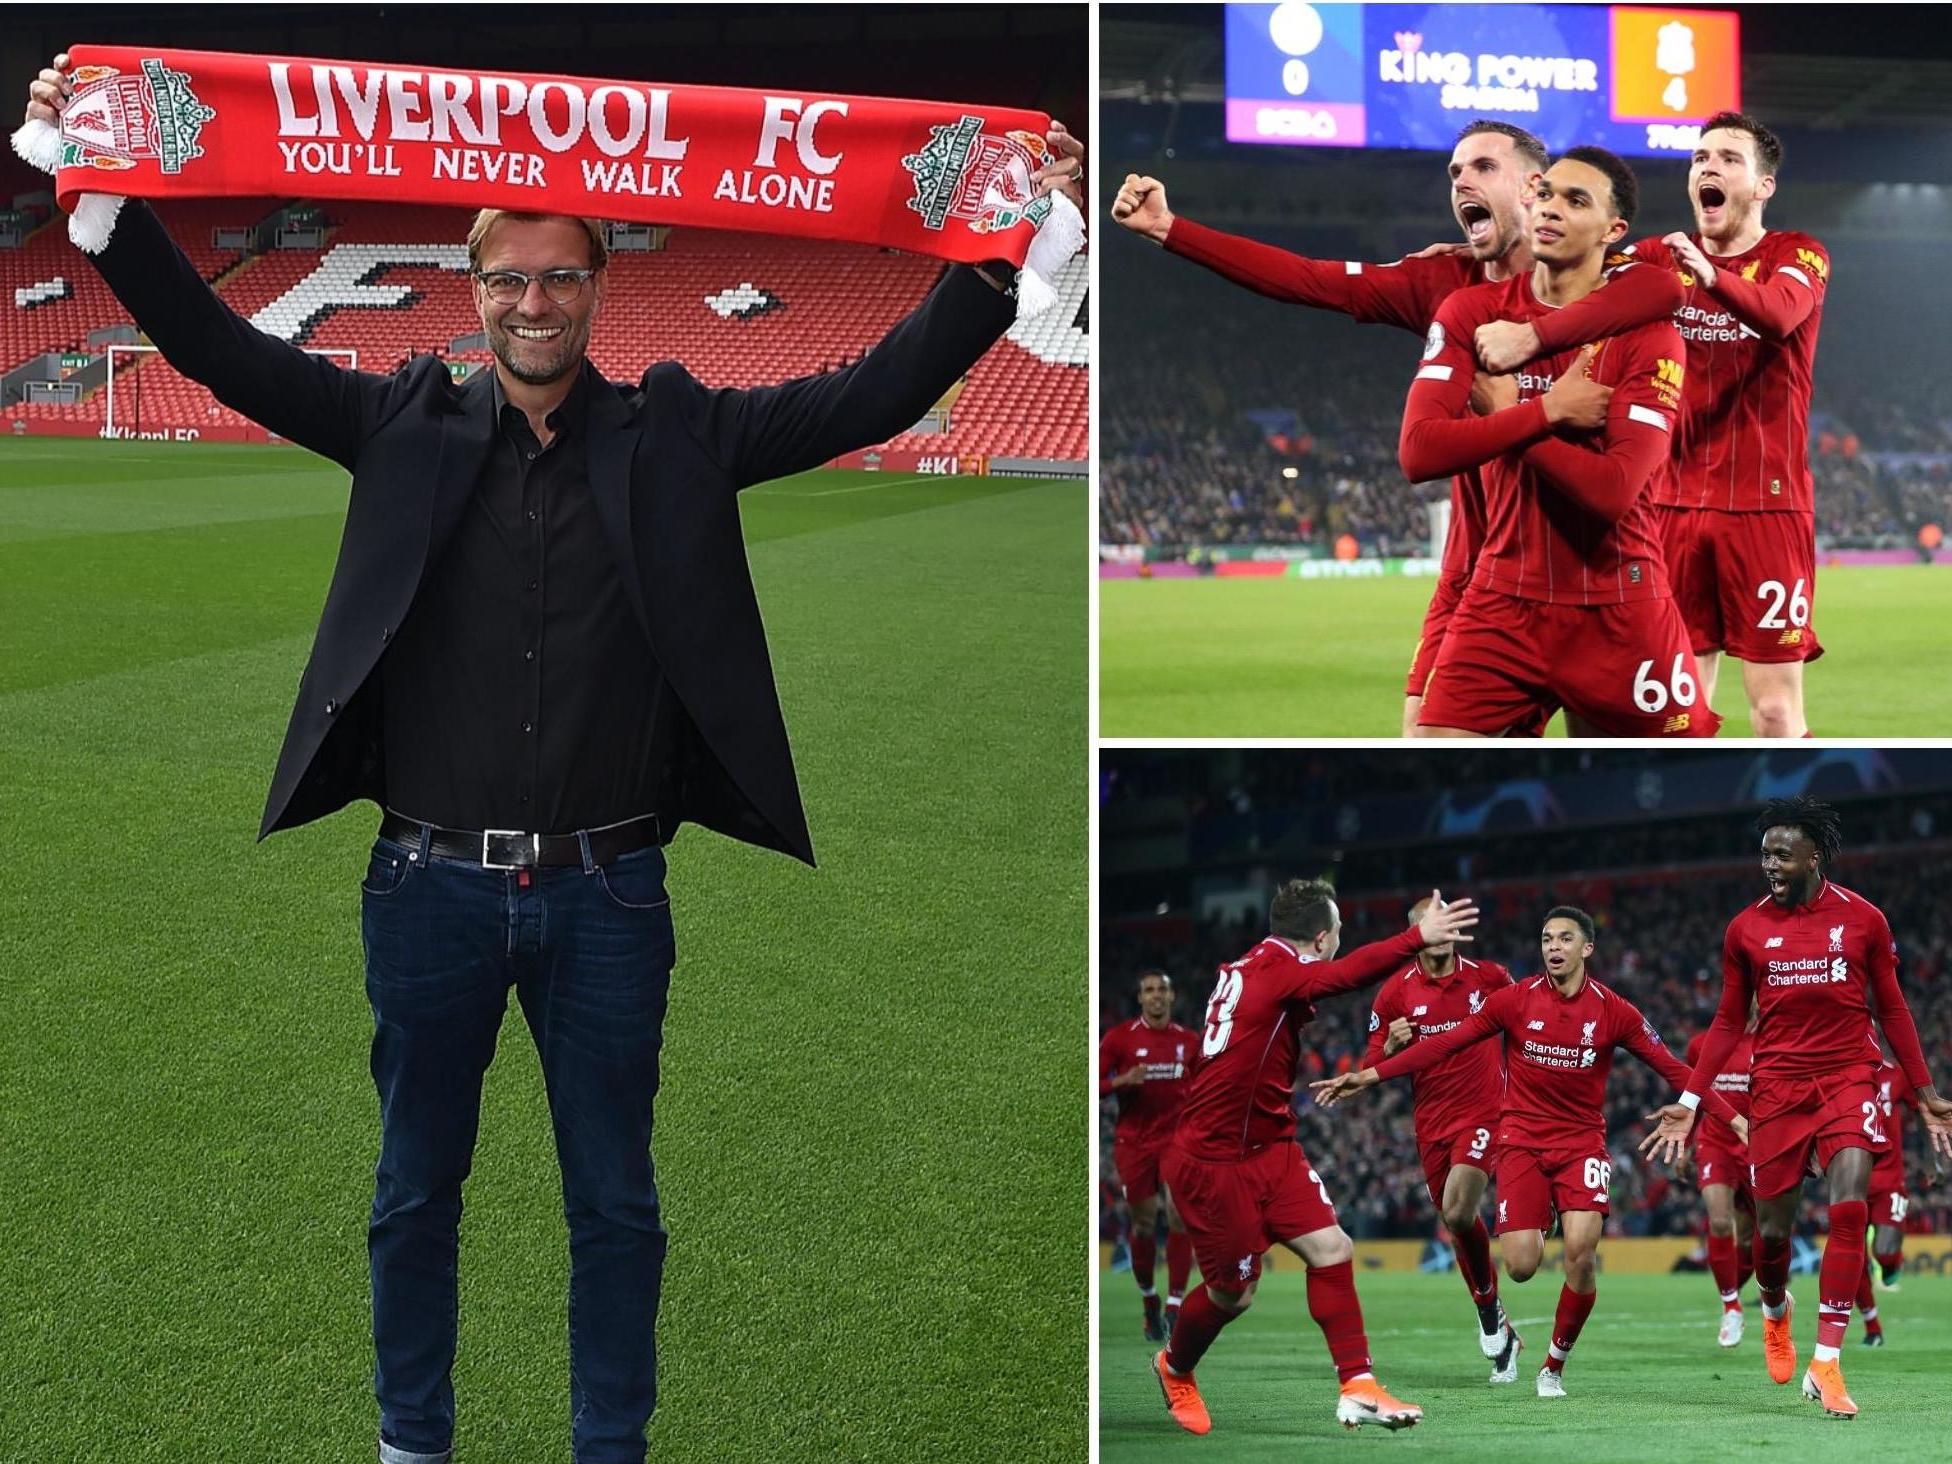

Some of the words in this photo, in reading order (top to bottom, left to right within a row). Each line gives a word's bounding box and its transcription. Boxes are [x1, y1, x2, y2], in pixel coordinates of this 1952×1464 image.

[1282, 59, 1309, 95] 0
[1379, 49, 1472, 86] KING
[1477, 54, 1598, 91] POWER
[1662, 76, 1688, 112] 4
[120, 83, 148, 151] LIVERPOOL
[267, 62, 690, 161] LIVERPOOL
[752, 96, 850, 176] FC
[277, 141, 402, 177] YOU'LL
[432, 147, 548, 188] NEVER
[581, 159, 684, 198] WALK
[713, 170, 836, 214] ALONE
[961, 146, 1003, 211] LIVERPOOL
[1756, 578, 1809, 629] 26
[1633, 652, 1697, 714] 66
[1767, 971, 1828, 987] Chartered
[1768, 957, 1828, 973] Standard
[1419, 1020, 1461, 1034] Standa
[1524, 1040, 1580, 1058] Standard
[1471, 1127, 1490, 1150] 3
[1584, 1157, 1611, 1196] 66
